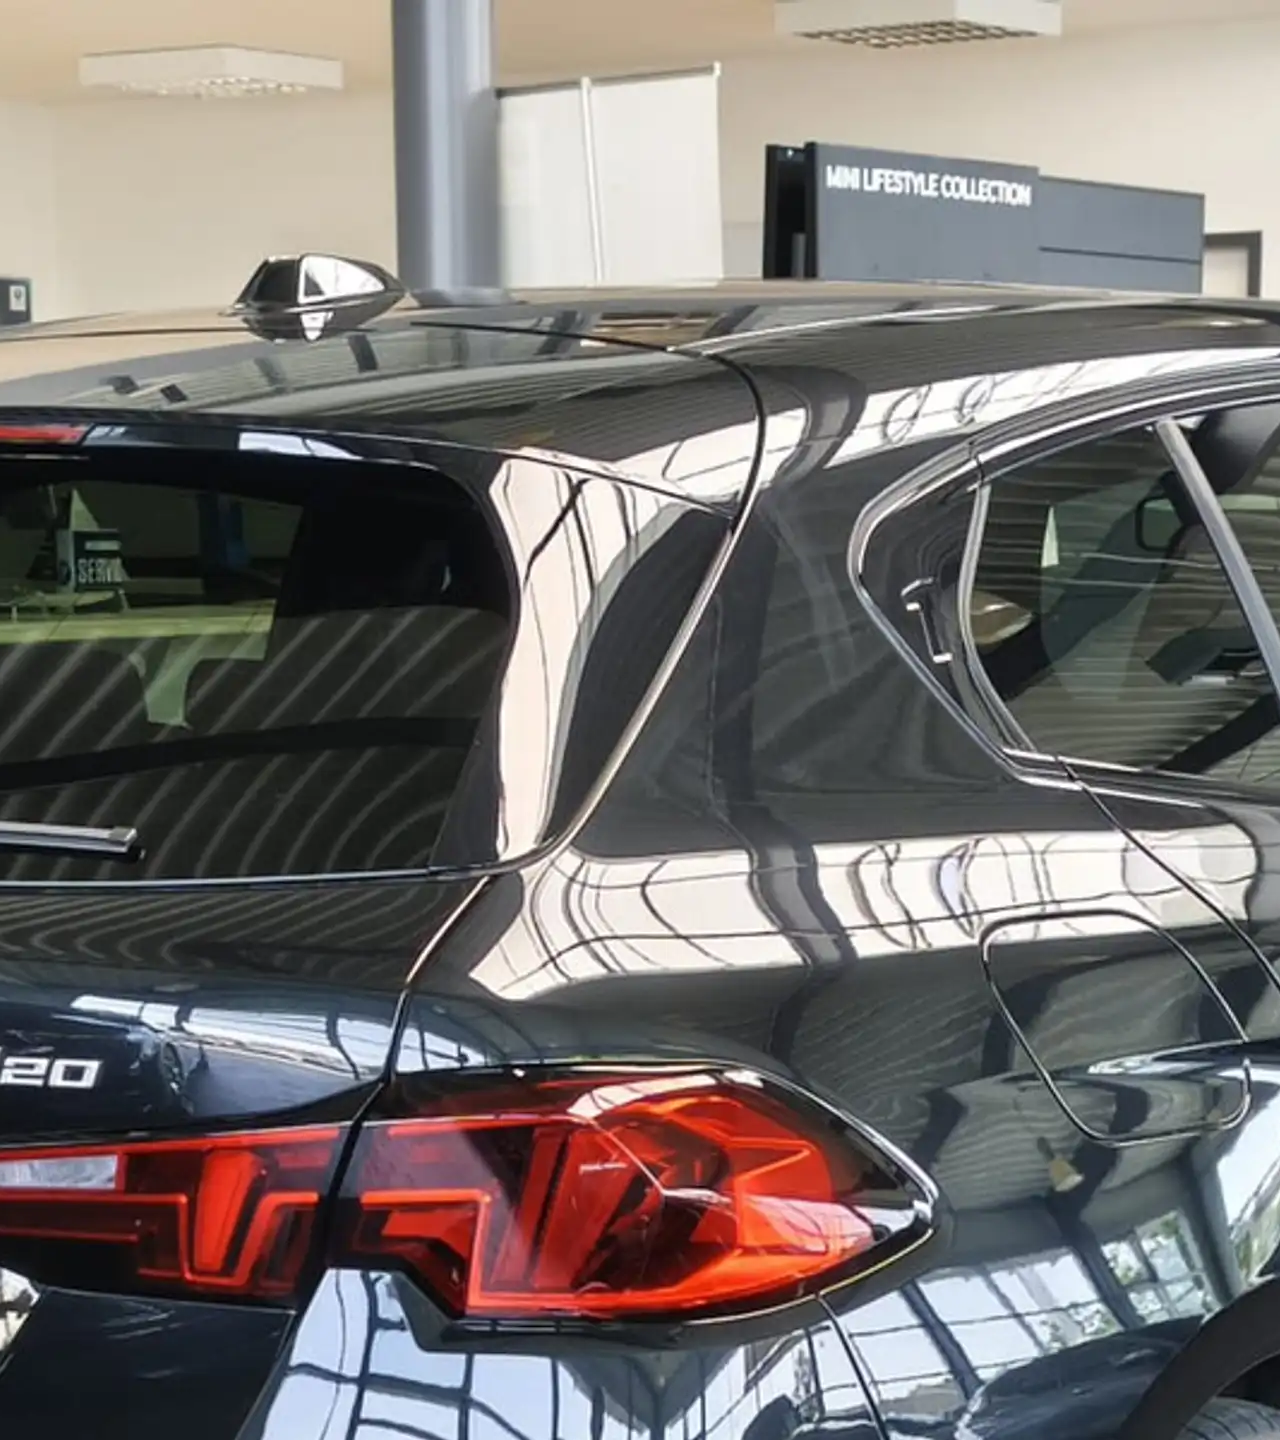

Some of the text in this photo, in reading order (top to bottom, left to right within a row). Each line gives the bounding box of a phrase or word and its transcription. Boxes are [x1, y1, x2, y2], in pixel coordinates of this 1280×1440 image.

[825, 164, 1032, 207] MINI LIFESTYLE COLLECTION
